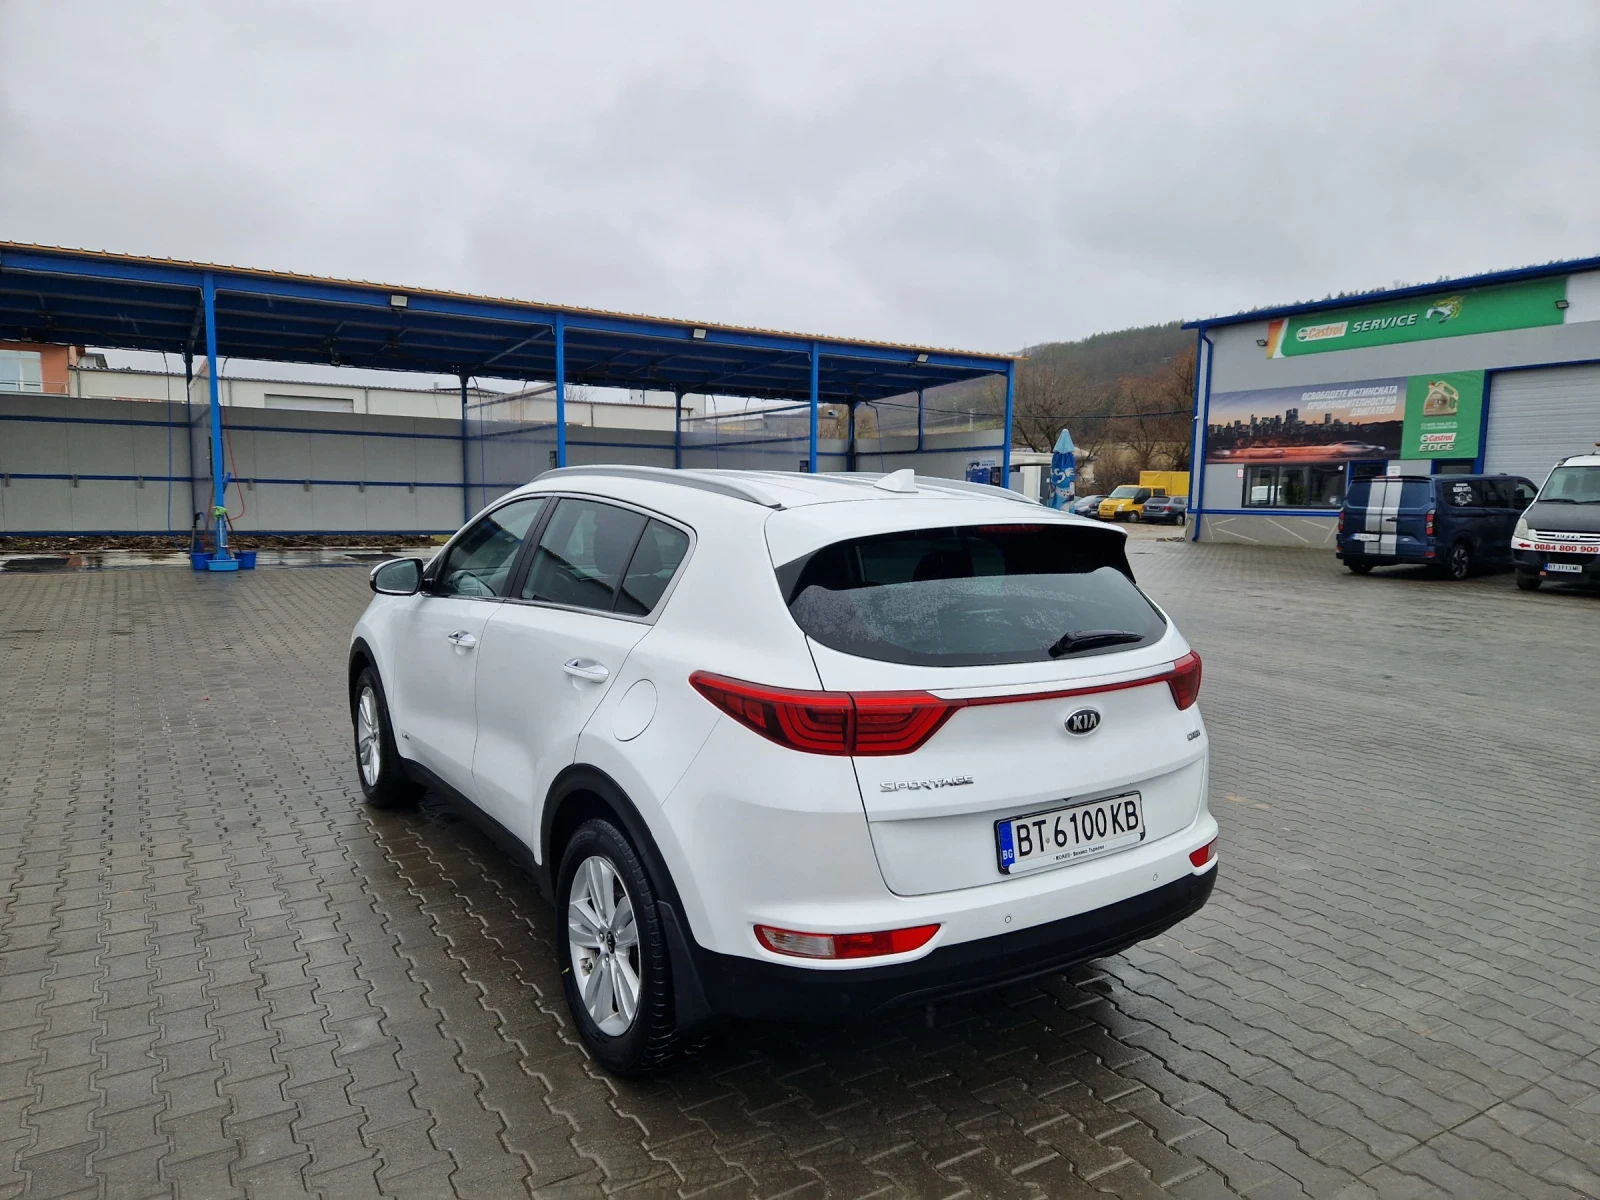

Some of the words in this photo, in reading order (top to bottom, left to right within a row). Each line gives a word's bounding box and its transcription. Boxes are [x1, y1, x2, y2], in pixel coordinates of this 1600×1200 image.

[1308, 324, 1344, 339] Castrol
[1352, 313, 1418, 333] SERVICE
[1428, 434, 1454, 442] Castrol
[1419, 443, 1455, 452] EDGE
[1073, 713, 1097, 730] KIA
[880, 775, 974, 793] SPORTAGE
[1002, 849, 1013, 860] BG
